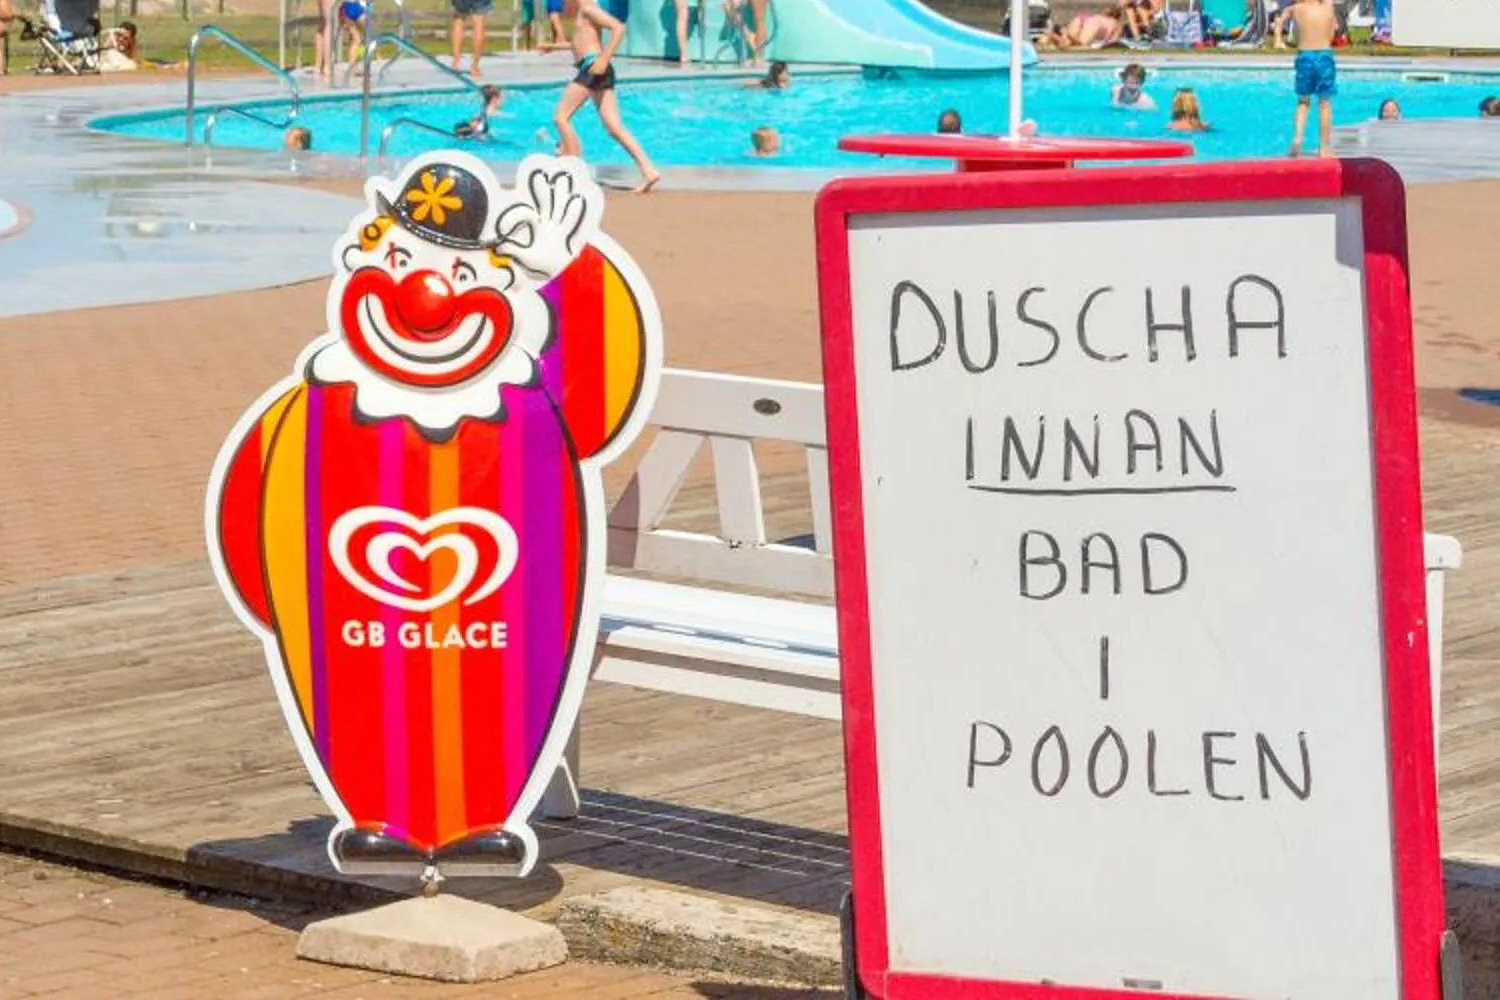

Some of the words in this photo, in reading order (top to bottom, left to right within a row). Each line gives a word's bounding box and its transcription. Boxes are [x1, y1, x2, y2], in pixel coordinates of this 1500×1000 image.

[889, 274, 1288, 374] DUSCHA
[965, 409, 1225, 482] INNAN
[1019, 530, 1189, 600] BAD
[340, 619, 386, 647] GB
[397, 621, 508, 649] GLACE
[1100, 636, 1110, 700] I
[966, 722, 1313, 801] POOLEN
